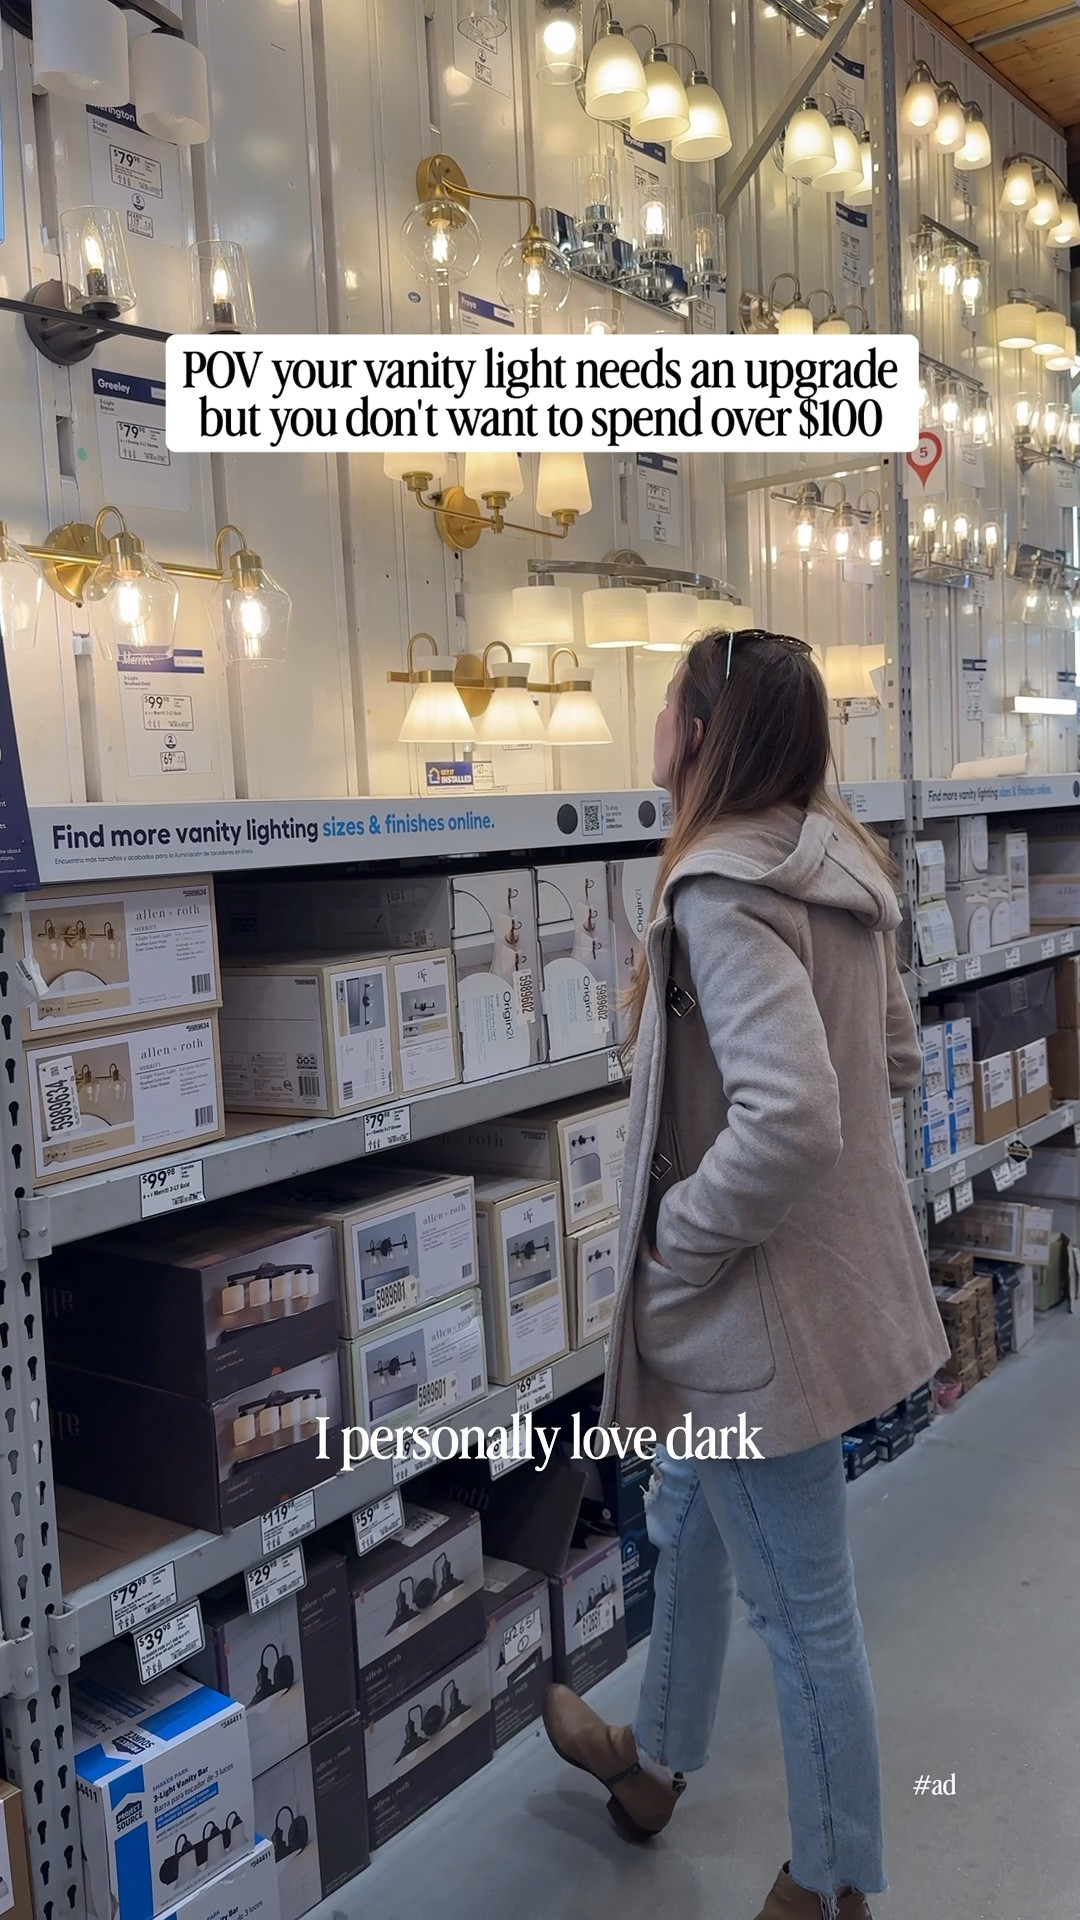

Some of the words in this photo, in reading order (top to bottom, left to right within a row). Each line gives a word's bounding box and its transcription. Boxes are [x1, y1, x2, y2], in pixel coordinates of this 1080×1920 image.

[97, 378, 131, 394] Greeley
[919, 447, 928, 459] 5
[440, 775, 472, 784] INSTALLED
[928, 790, 941, 802] Find
[52, 824, 105, 850] Find
[110, 827, 171, 846] more
[175, 819, 242, 846] vanity
[246, 817, 318, 846] lighting
[322, 816, 364, 837] sizes
[368, 815, 381, 835] &
[385, 813, 444, 834] finishes
[448, 811, 495, 831] online.
[54, 857, 84, 865] Encuentra
[127, 853, 154, 861] acabados
[136, 909, 166, 921] allen
[177, 904, 201, 916] roth
[635, 888, 645, 933] Origin21
[519, 974, 534, 1014] 5989602
[582, 975, 593, 1022] Origin21
[596, 984, 608, 1021] 5989602
[502, 991, 515, 1041] Origin21
[140, 1047, 170, 1060] allen
[181, 1038, 204, 1052] roth
[45, 1078, 73, 1132] 5989634
[467, 1133, 504, 1148] roth
[422, 1213, 443, 1226] allen
[450, 1202, 466, 1216] roth
[375, 1280, 406, 1311] 5989601
[431, 1326, 452, 1342] allen
[418, 1377, 447, 1408] 5989601
[387, 1654, 402, 1668] roth
[123, 1730, 155, 1750] SOURCE
[152, 1776, 174, 1792] SHAKER
[174, 1767, 189, 1779] PARK
[152, 1784, 176, 1803] 3-Light
[176, 1774, 197, 1790] Vanity
[197, 1766, 209, 1777] Bar
[154, 1800, 171, 1814] Barra
[171, 1792, 185, 1805] para
[184, 1780, 206, 1797] tocador
[206, 1774, 215, 1784] de
[218, 1763, 234, 1776] luces
[116, 1803, 142, 1821] PROJECT
[116, 1811, 144, 1833] SOURCE
[228, 1906, 239, 1918] Bar
[249, 1900, 263, 1911] luces
